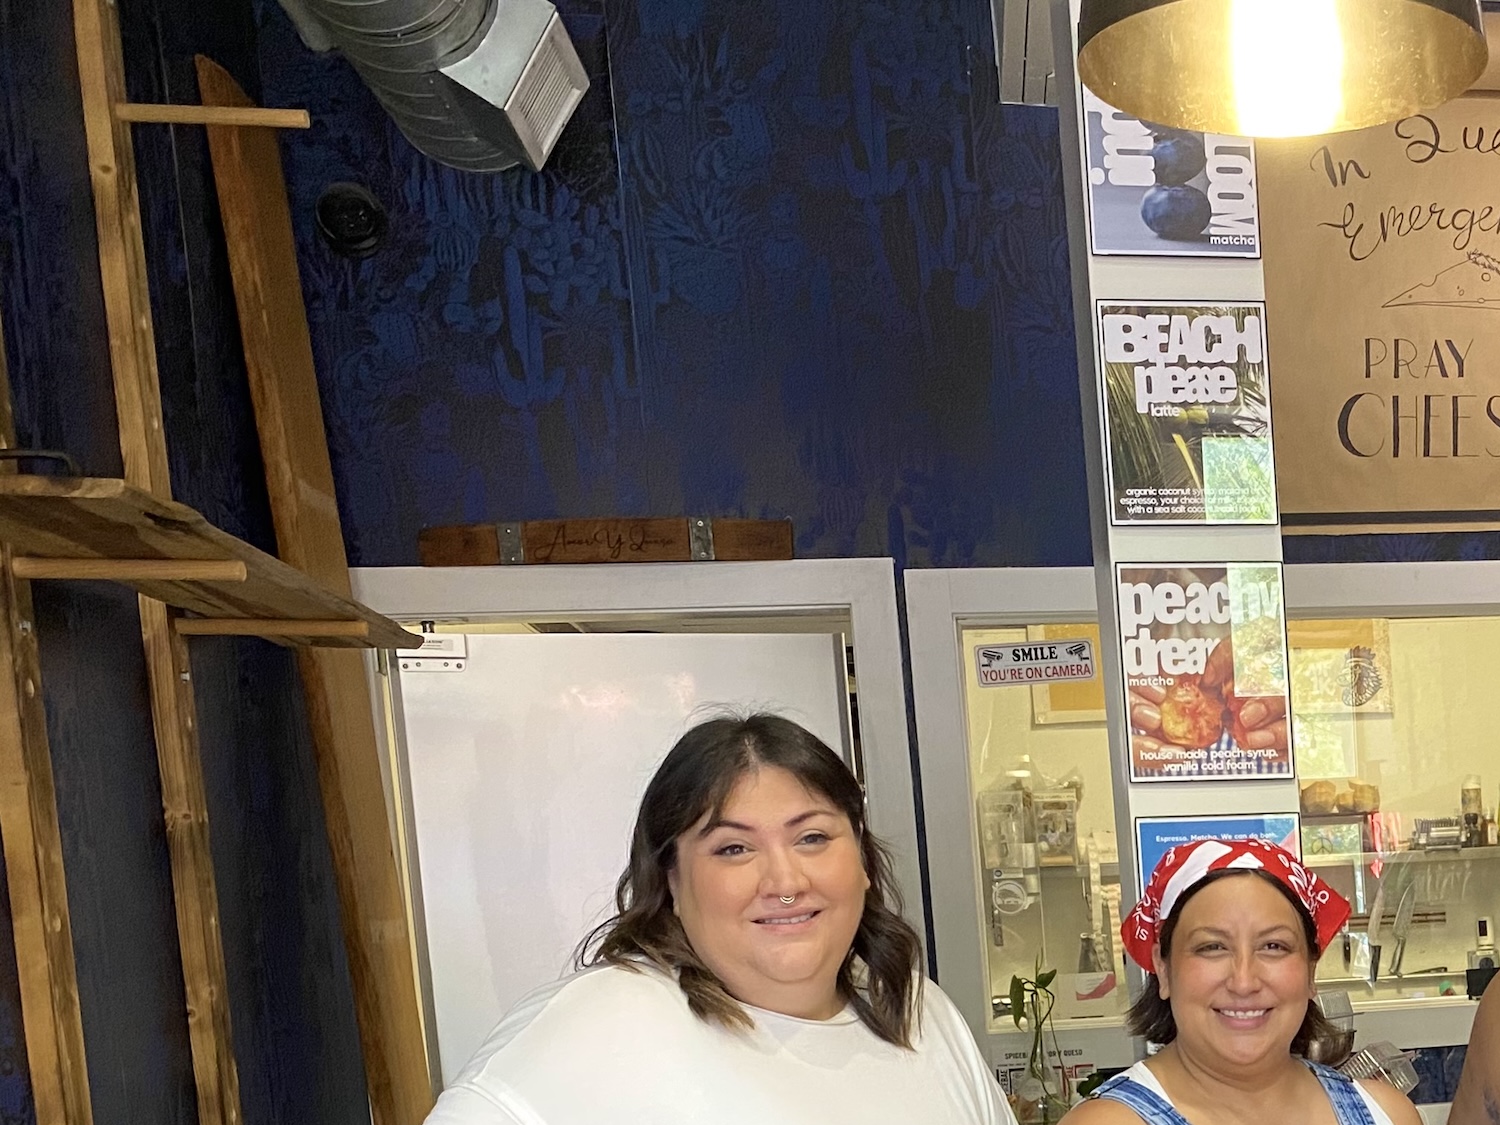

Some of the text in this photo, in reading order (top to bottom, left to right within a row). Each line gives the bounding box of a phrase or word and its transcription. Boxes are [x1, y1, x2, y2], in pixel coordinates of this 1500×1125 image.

[1311, 146, 1370, 187] In
[1210, 235, 1255, 245] matcha
[1103, 314, 1262, 363] BEACH
[1365, 338, 1474, 378] PRAY
[1134, 357, 1238, 413] please
[1151, 404, 1181, 417] latte
[1126, 486, 1157, 497] organic
[1158, 488, 1190, 496] coconut
[1120, 498, 1158, 506] espresso,
[1160, 498, 1178, 506] your
[1127, 505, 1145, 515] with
[1171, 505, 1186, 514] salt
[1012, 646, 1058, 661] SMILE
[982, 664, 1091, 682] YOU'RE ON CAMERA
[1129, 676, 1175, 687] matcha
[1140, 749, 1278, 760] house made peach syrup.
[1163, 759, 1257, 771] vanilla cold foam.
[1156, 835, 1188, 843] Espresso.
